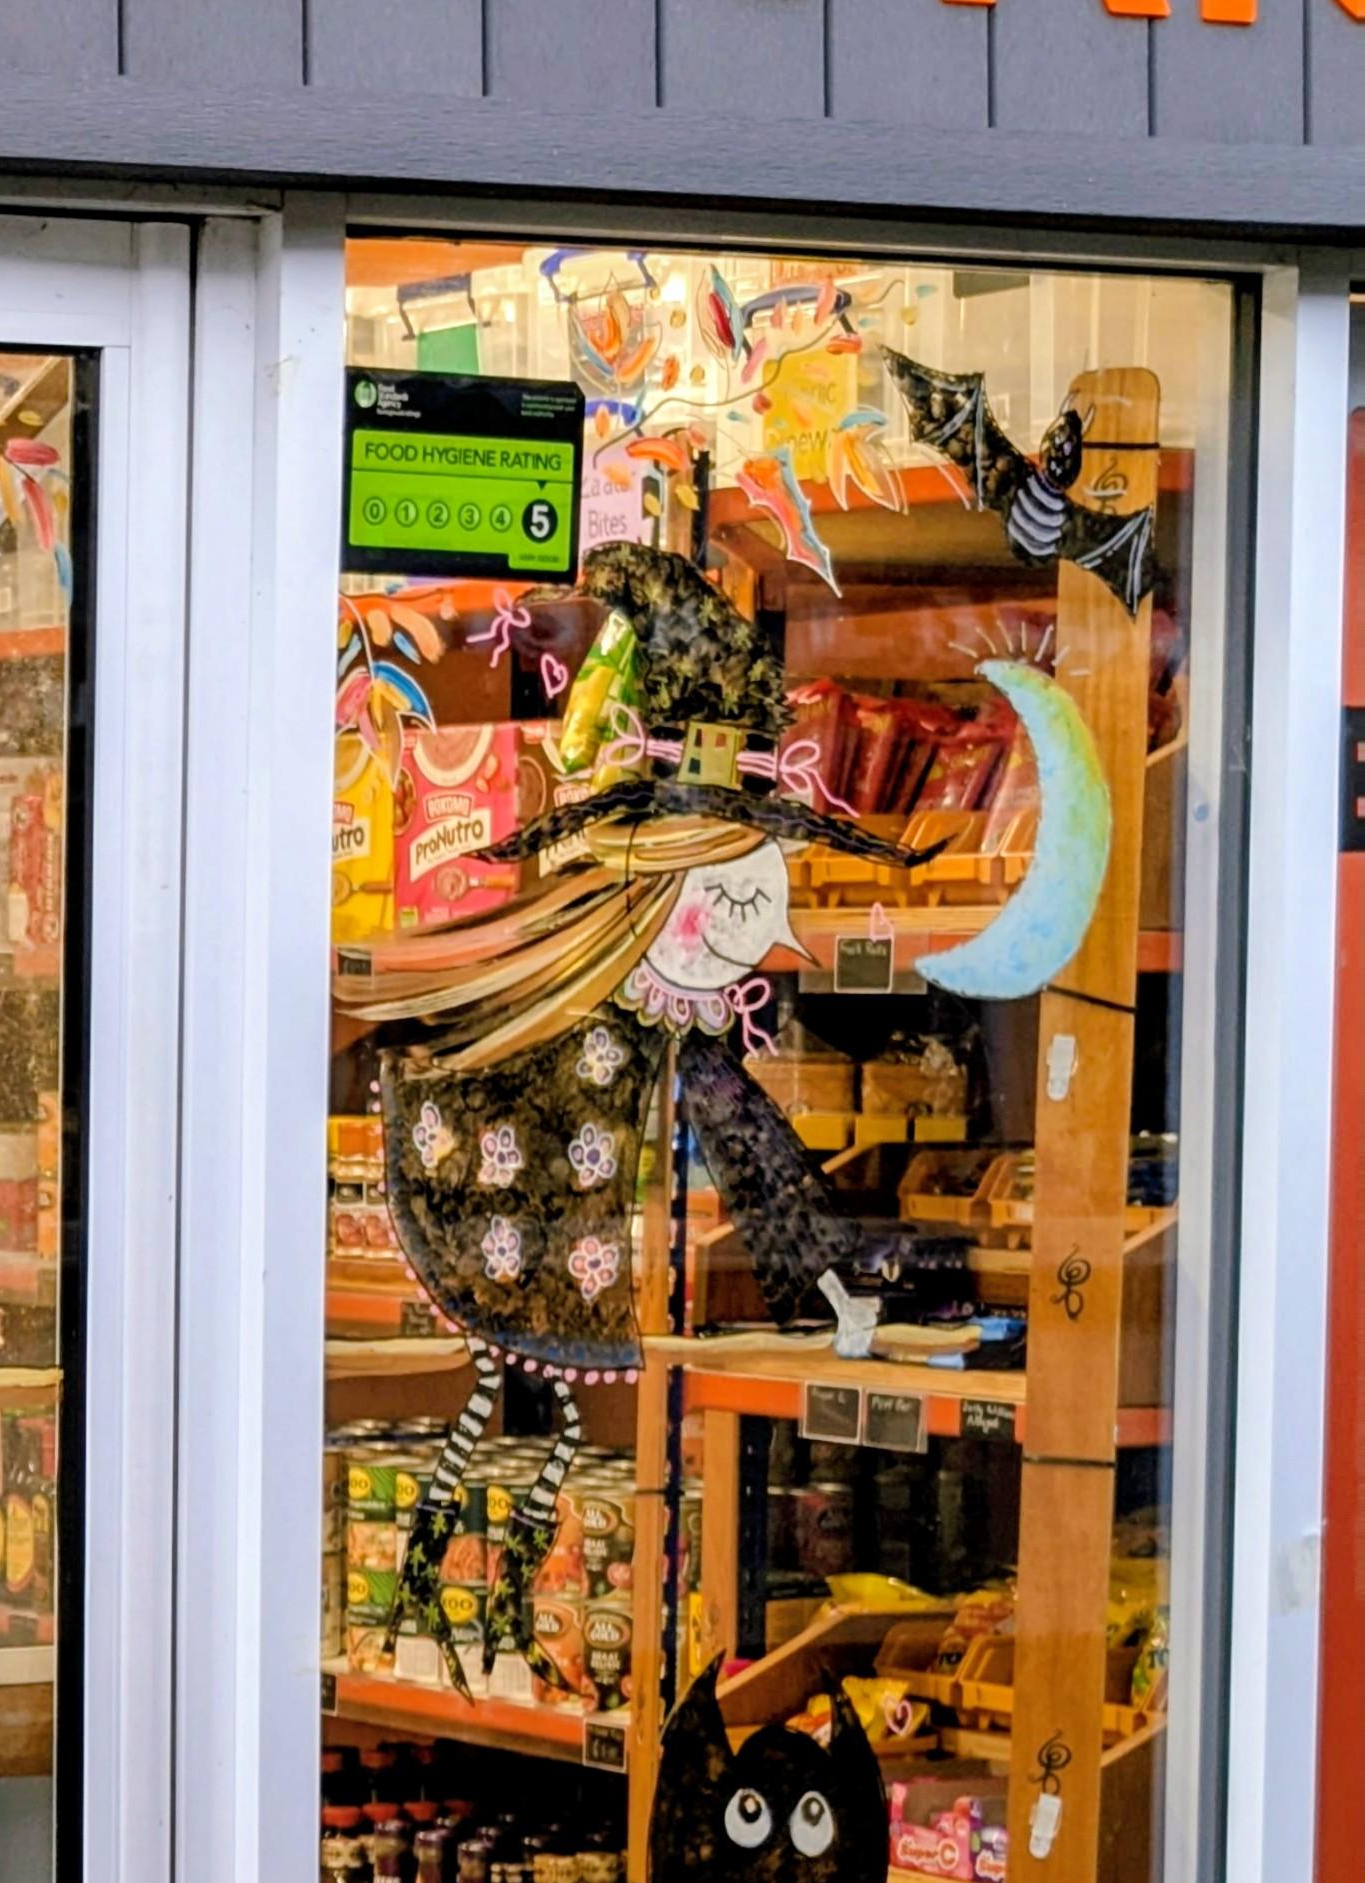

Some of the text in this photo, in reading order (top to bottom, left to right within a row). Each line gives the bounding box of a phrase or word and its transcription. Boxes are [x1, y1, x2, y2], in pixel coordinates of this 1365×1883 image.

[364, 442, 562, 472] FOOD HYGIENE RATING
[369, 502, 380, 519] 0
[434, 506, 444, 523] 2
[464, 507, 475, 525] 3
[495, 509, 507, 526] 4
[529, 504, 551, 539] 5
[588, 509, 628, 539] Bites
[414, 818, 484, 865] ProNutro
